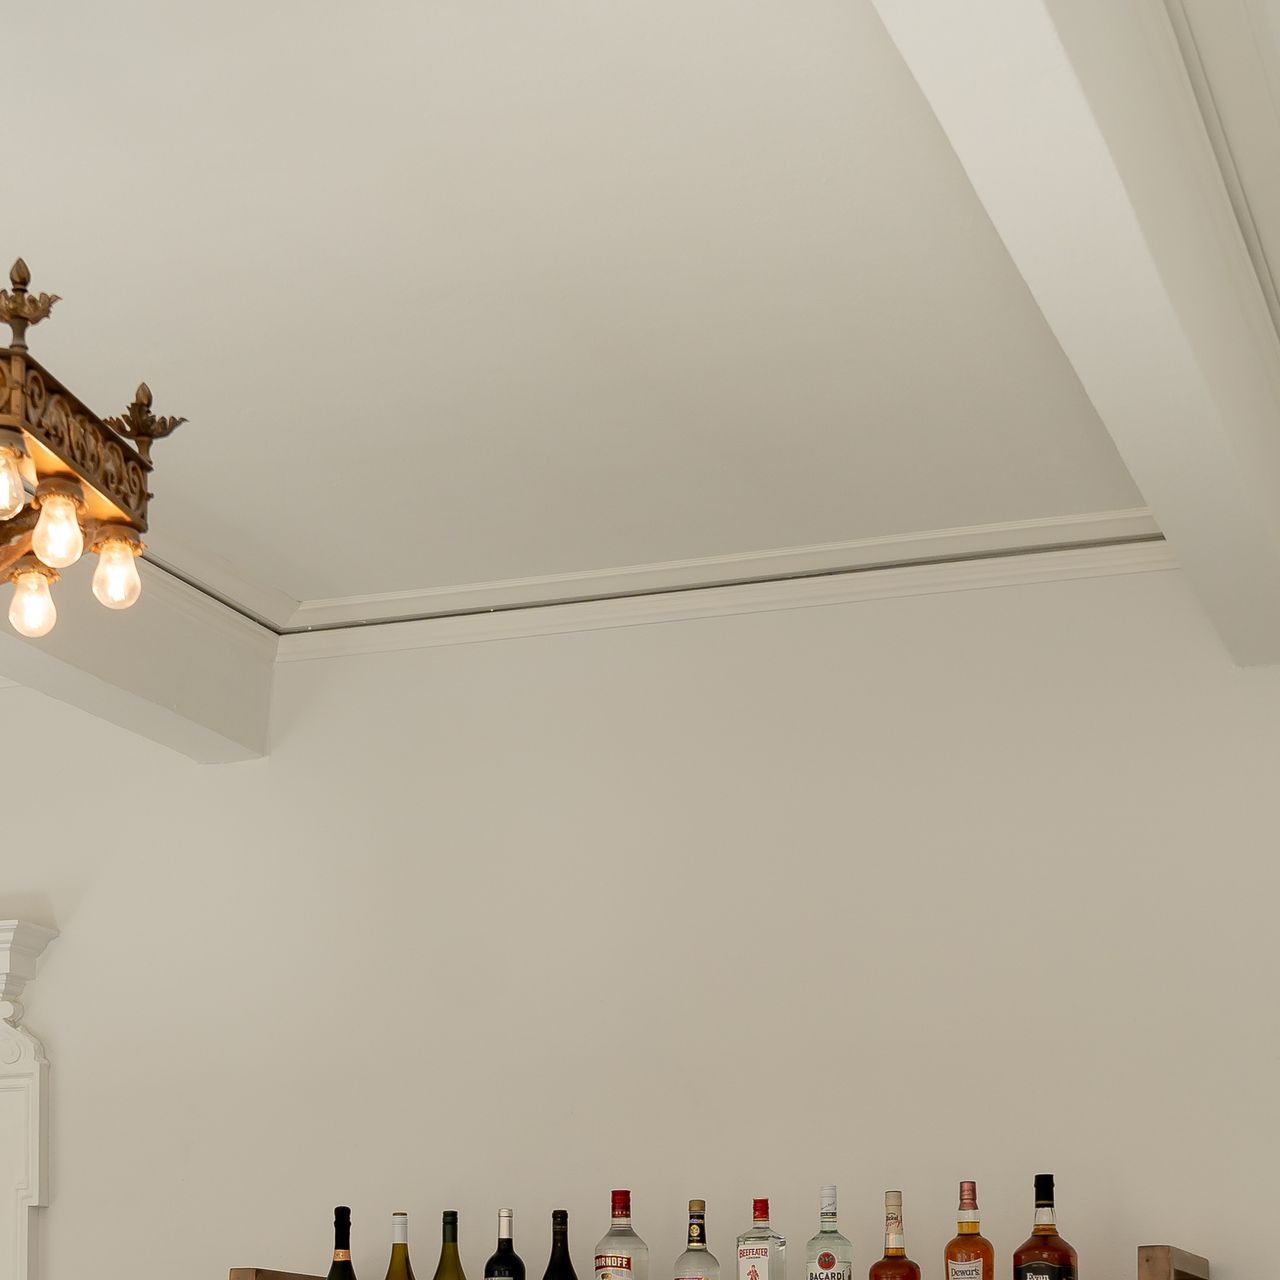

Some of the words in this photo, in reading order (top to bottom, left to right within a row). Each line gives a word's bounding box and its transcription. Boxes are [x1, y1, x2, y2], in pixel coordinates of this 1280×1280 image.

[739, 1247, 768, 1258] BEEFEATER
[809, 1270, 845, 1280] BACARDÍ
[1026, 1272, 1050, 1280] Evan
